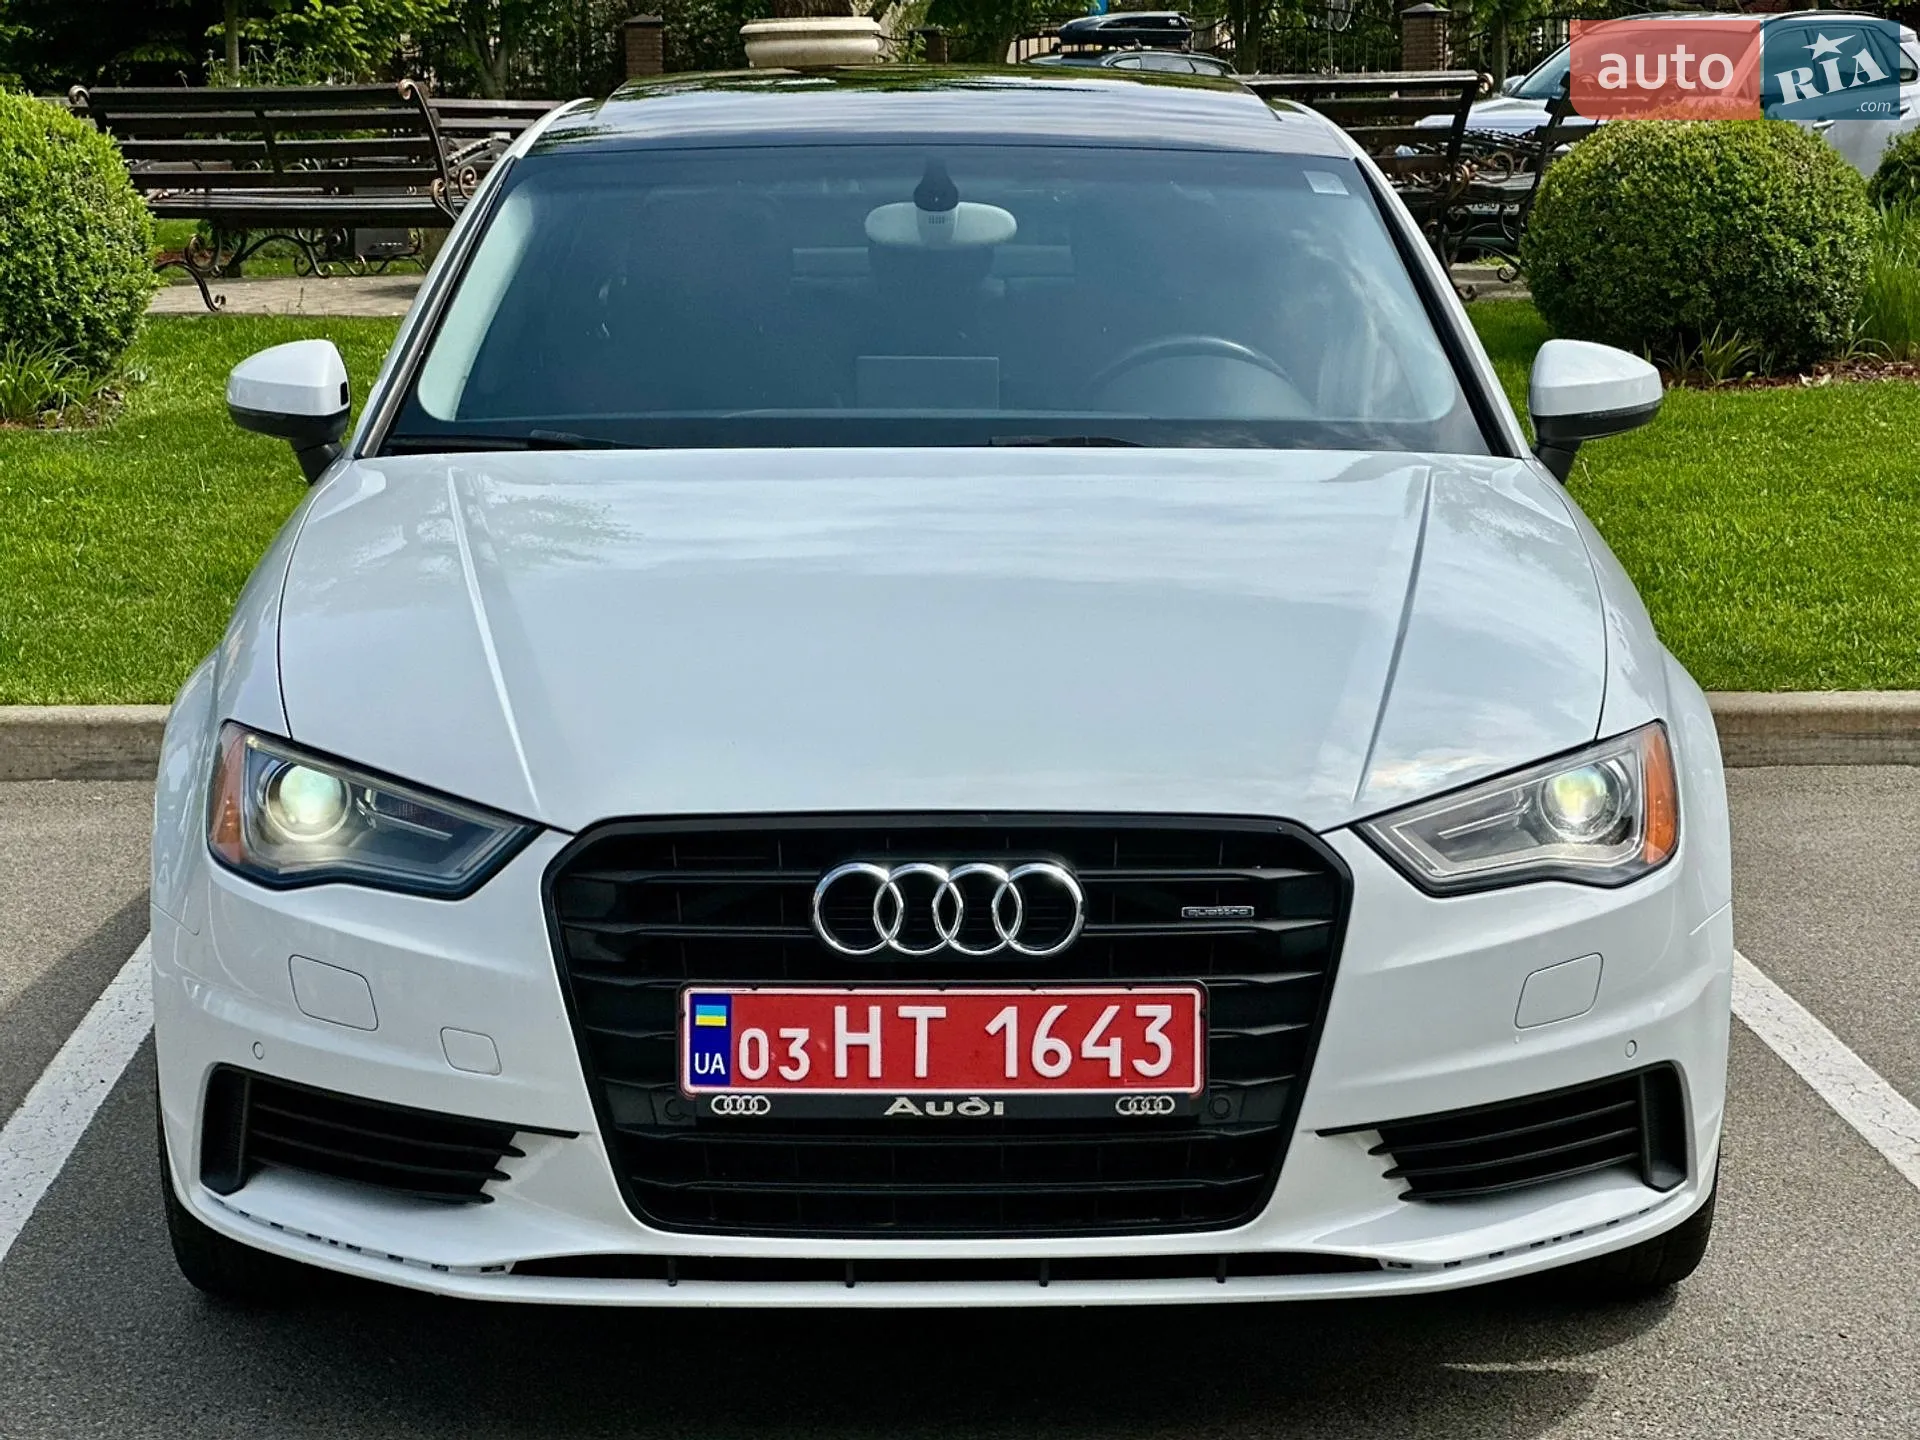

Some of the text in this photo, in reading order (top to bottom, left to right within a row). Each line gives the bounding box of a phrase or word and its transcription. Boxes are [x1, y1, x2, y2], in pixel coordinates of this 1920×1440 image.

[738, 1004, 1173, 1081] 03 HT 1643
[694, 1052, 726, 1075] UA
[883, 1096, 1004, 1116] Audi
